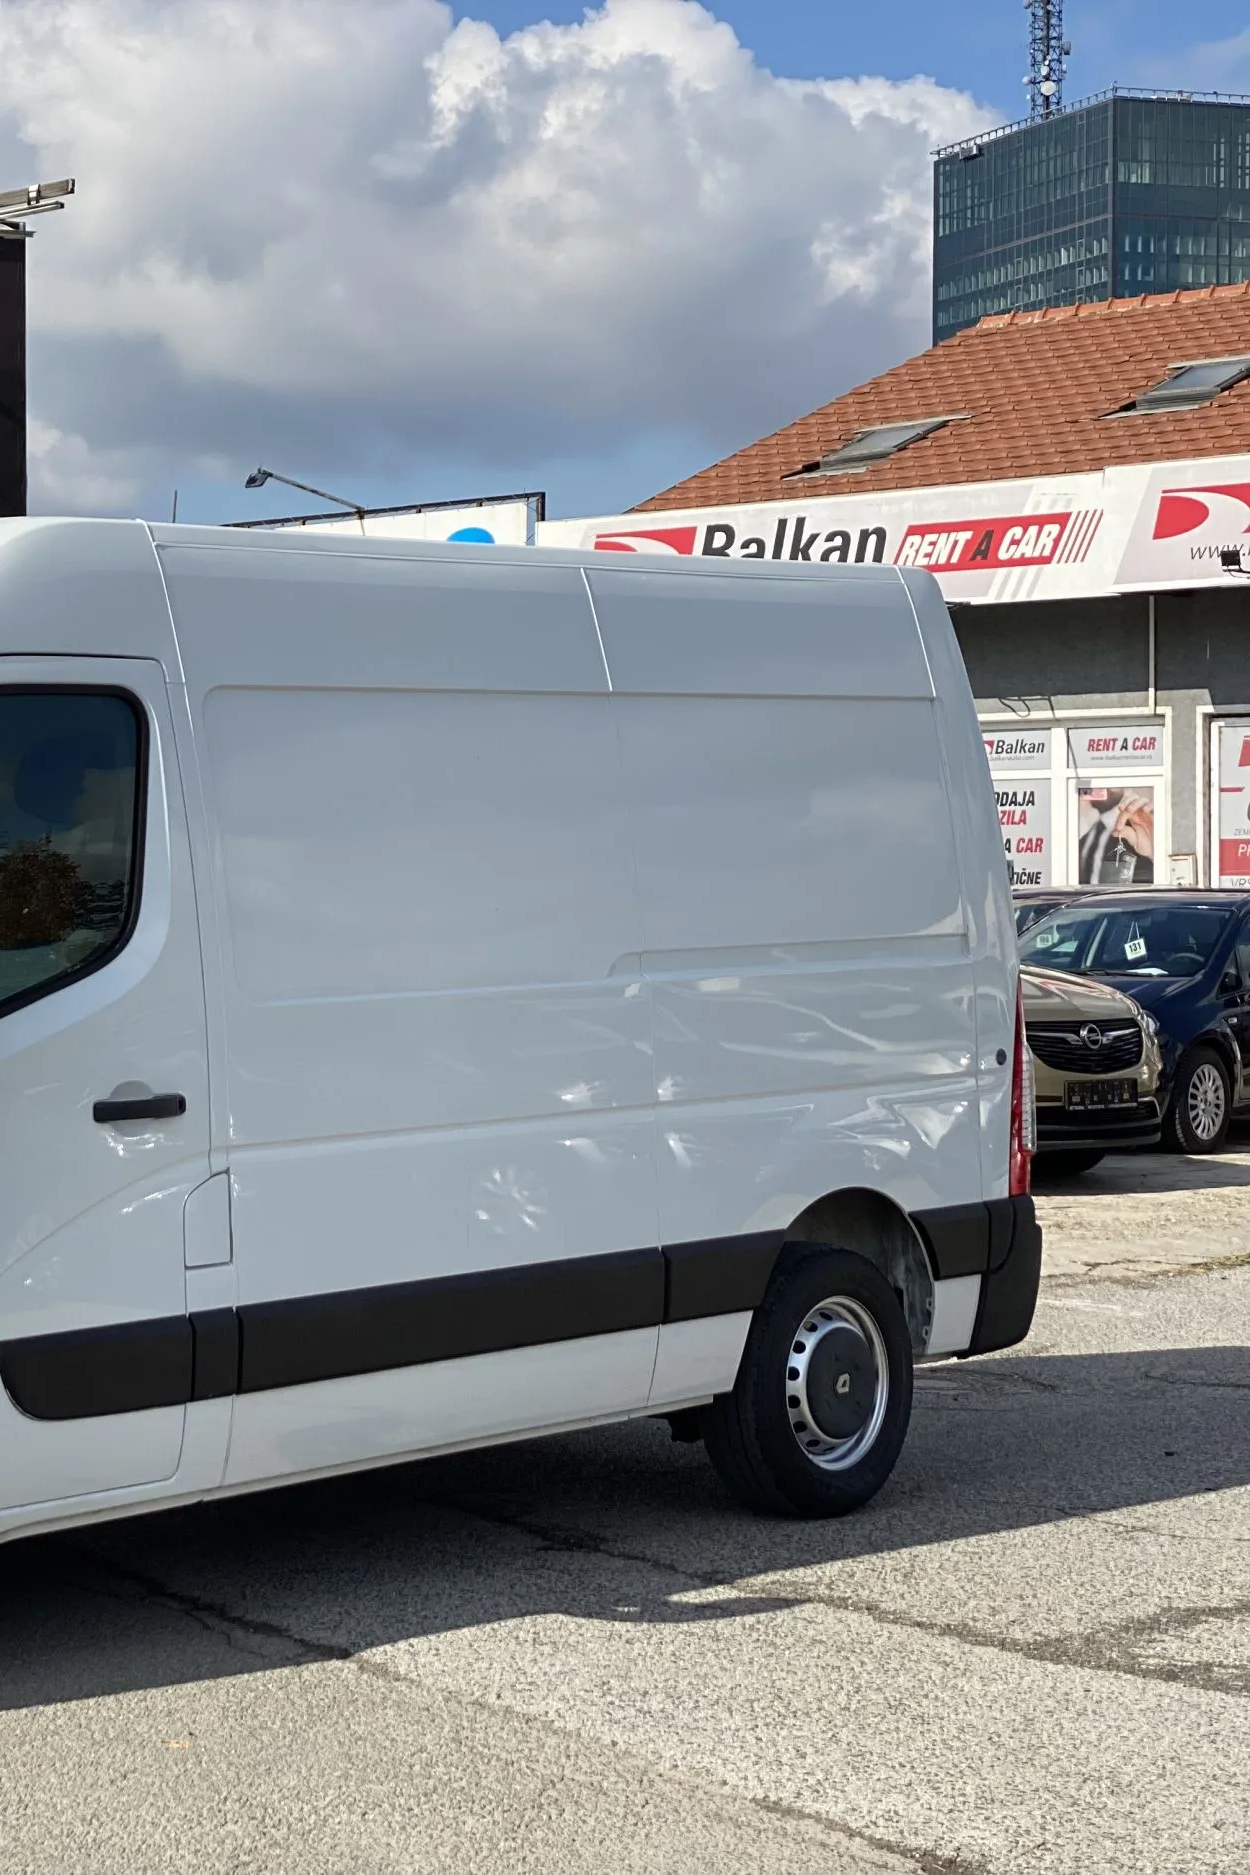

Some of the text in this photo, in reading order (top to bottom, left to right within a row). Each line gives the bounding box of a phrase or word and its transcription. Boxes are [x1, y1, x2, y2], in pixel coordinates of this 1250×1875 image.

[701, 516, 1061, 567] Balkan RENT A CAR
[994, 739, 1045, 755] Balkan
[1087, 736, 1157, 752] RENT A CAR
[1016, 837, 1044, 853] CAR
[1129, 942, 1142, 953] 131
